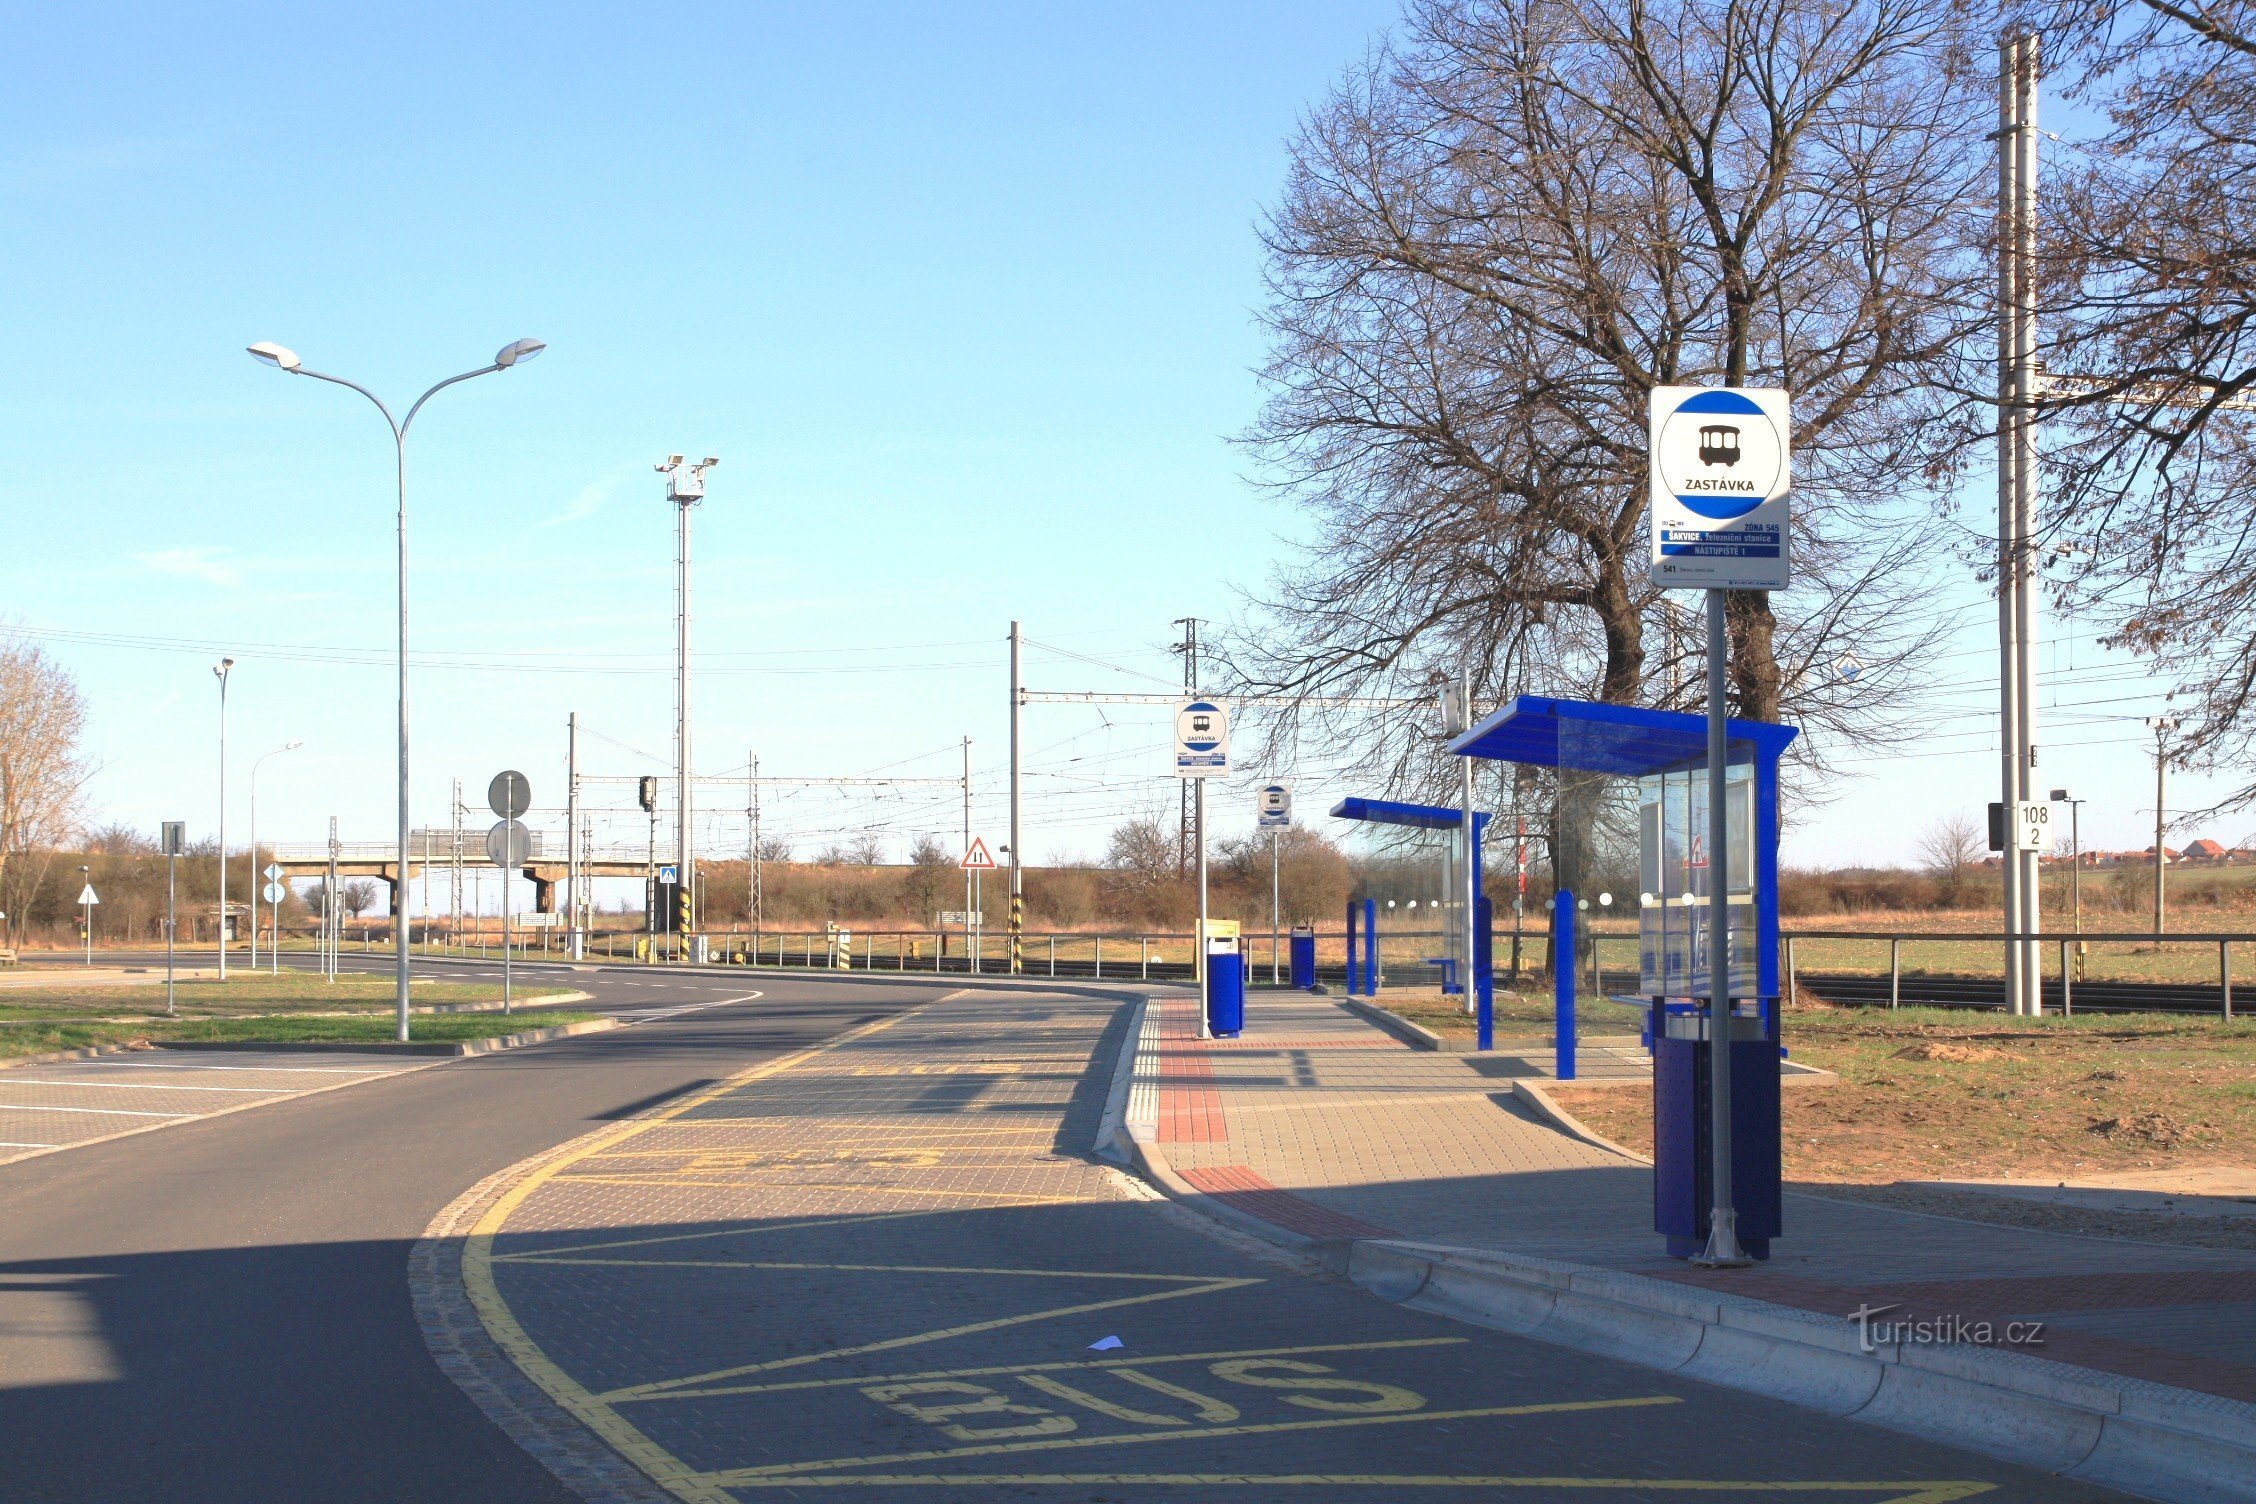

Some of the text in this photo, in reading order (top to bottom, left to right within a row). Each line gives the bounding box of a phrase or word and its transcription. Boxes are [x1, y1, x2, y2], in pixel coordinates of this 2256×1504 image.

[1685, 476, 1755, 491] ZASTÁVKA
[1744, 522, 1780, 532] ZÓNA 545
[1744, 534, 1771, 542] stanice
[1695, 545, 1739, 555] NÁSTUPIŠTĚ
[1663, 565, 1676, 573] 541
[2023, 807, 2048, 824] 108
[2031, 828, 2040, 845] 2
[858, 1358, 1428, 1441] BUS
